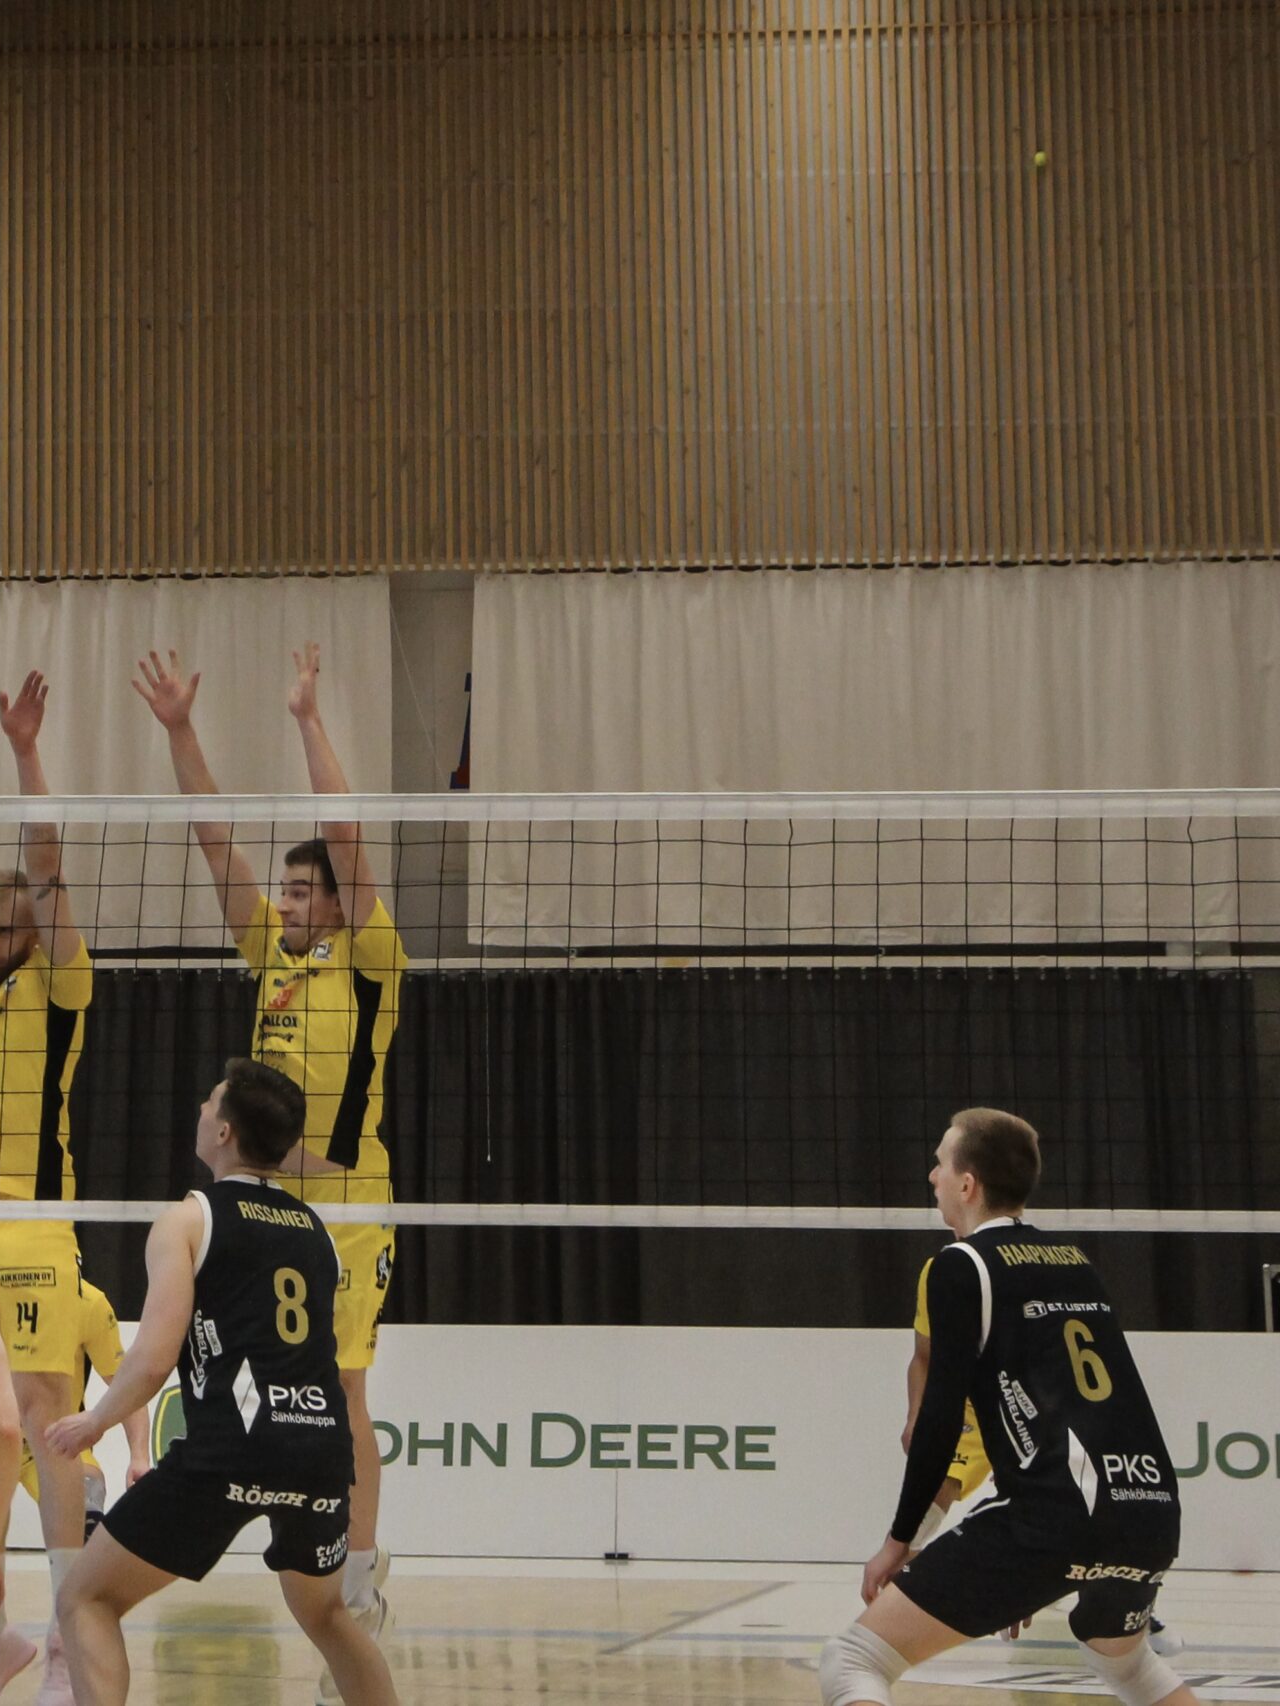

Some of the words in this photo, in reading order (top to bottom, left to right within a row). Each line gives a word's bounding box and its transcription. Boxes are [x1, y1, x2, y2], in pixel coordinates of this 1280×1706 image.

[237, 1201, 314, 1230] RISSANEN
[16, 1302, 38, 1333] 14
[273, 1267, 310, 1345] 8
[1063, 1319, 1113, 1402] 6
[268, 1384, 327, 1411] PKS
[271, 1410, 336, 1428] Sähkökauppa
[371, 1420, 508, 1468] OHN
[531, 1412, 776, 1471] DEERE
[1173, 1421, 1280, 1480] JO
[1102, 1454, 1161, 1484] PKS
[225, 1483, 308, 1508] RÖSCH
[312, 1497, 342, 1514] OY
[1065, 1563, 1150, 1582] RÖSCH
